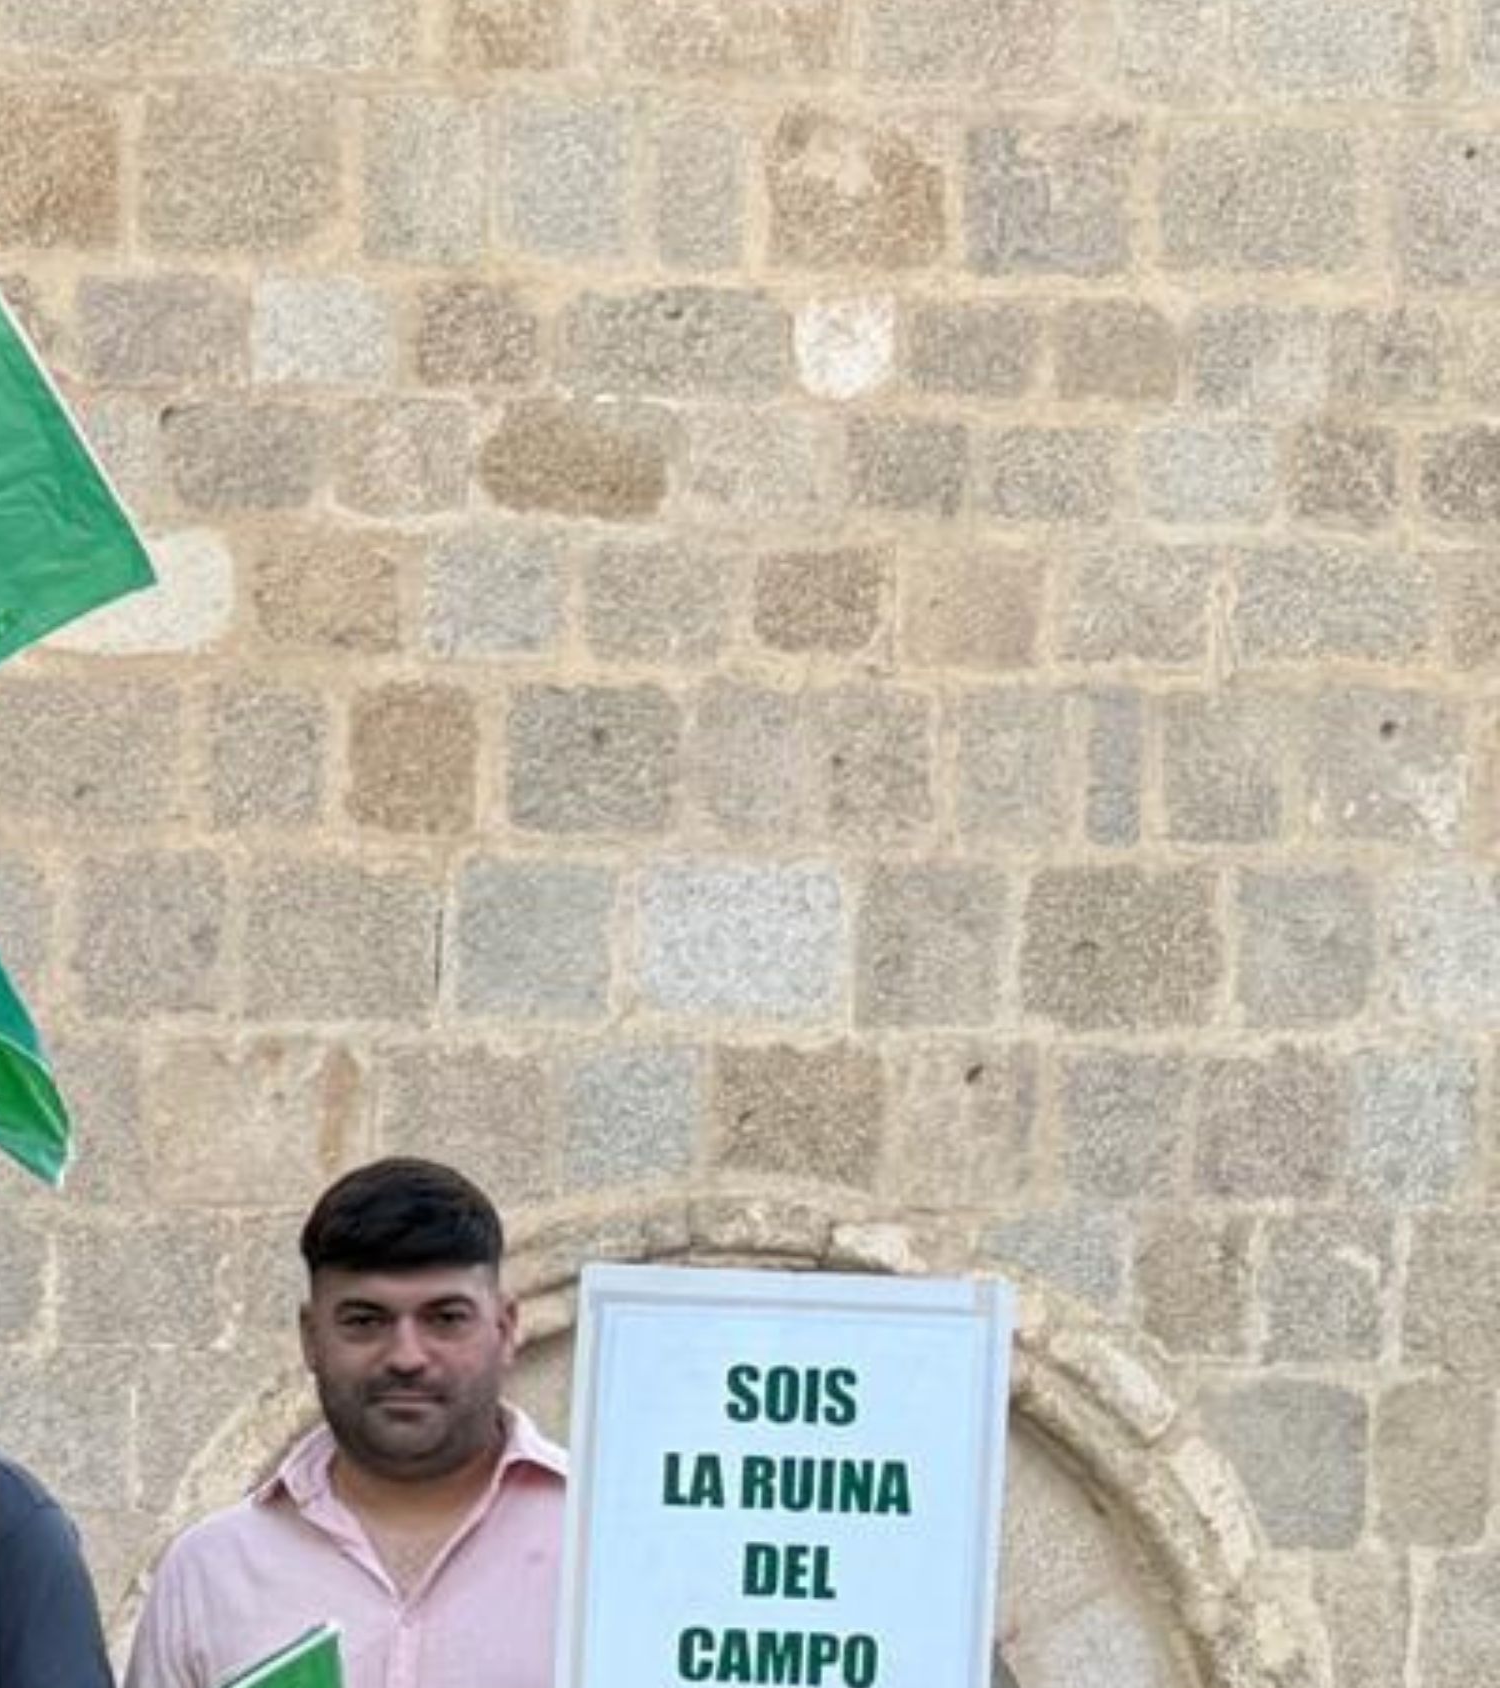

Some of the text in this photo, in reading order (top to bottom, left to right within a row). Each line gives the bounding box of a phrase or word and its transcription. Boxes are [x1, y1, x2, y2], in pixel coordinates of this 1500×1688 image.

[726, 1364, 858, 1426] SOIS
[662, 1453, 912, 1516] LA RUINA
[743, 1543, 836, 1600] DEL
